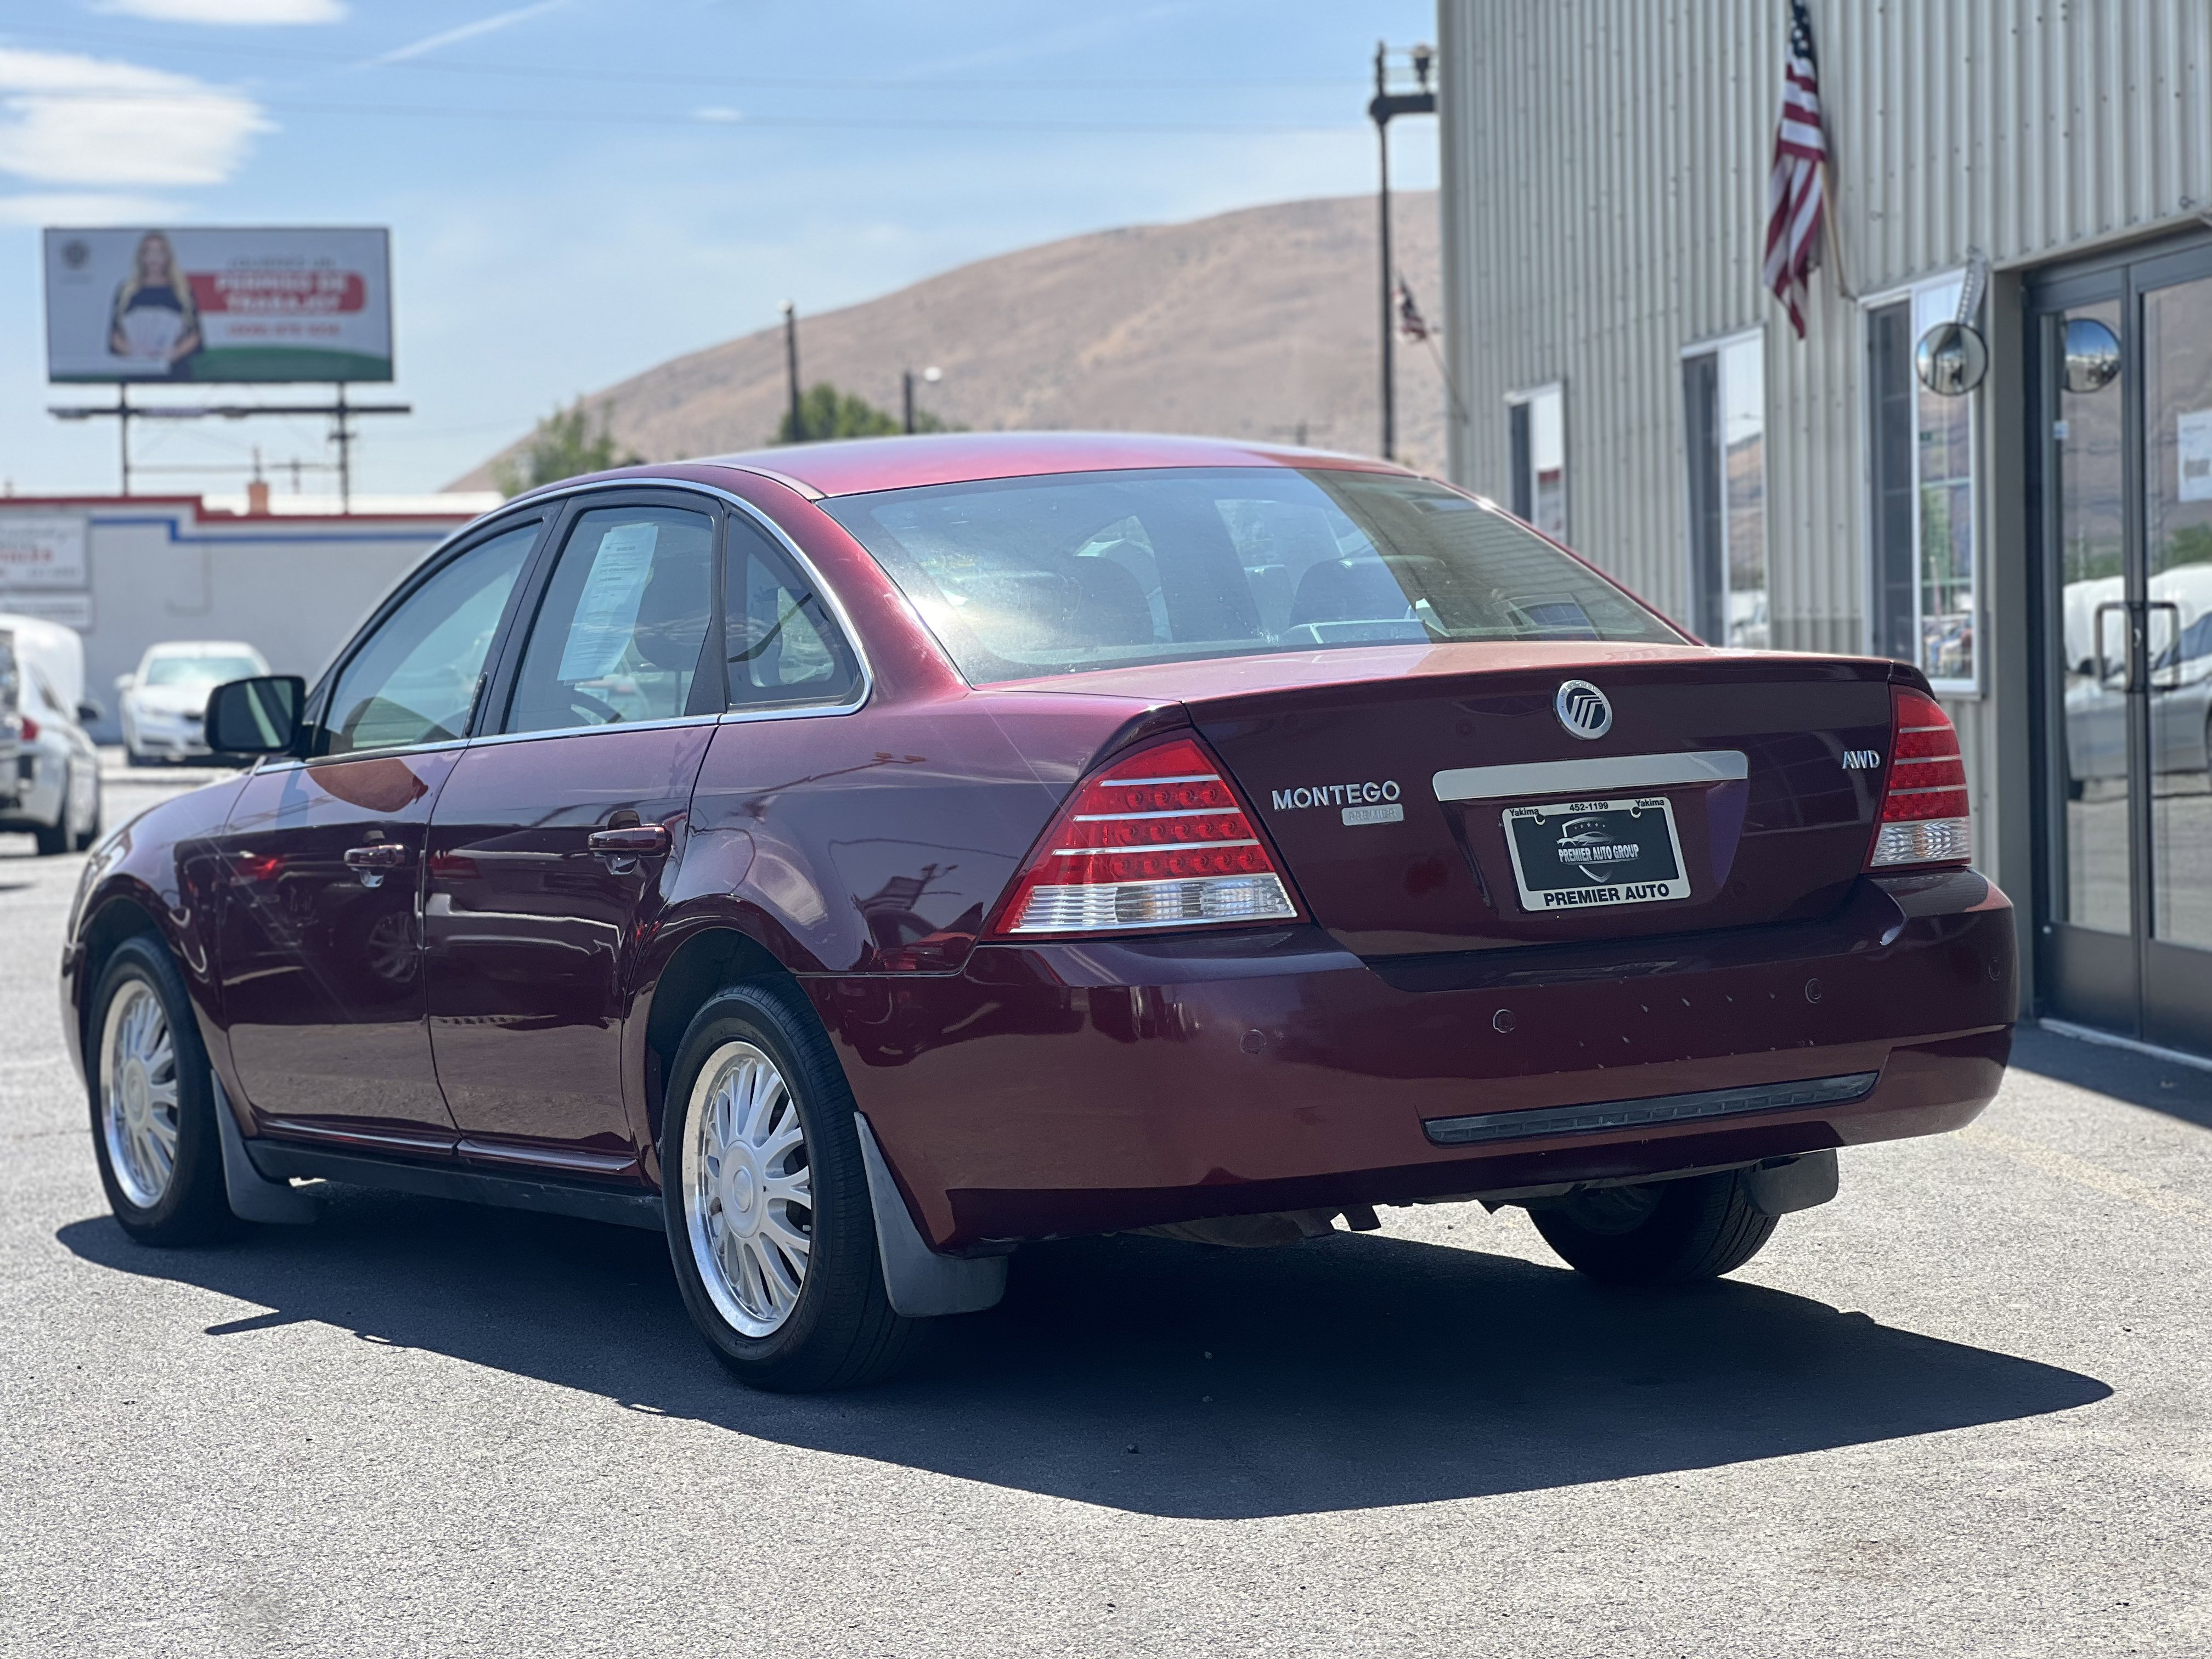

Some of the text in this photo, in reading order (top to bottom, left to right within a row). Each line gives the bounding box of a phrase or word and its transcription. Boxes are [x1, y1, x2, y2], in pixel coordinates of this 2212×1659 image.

[1842, 749, 1880, 769] AWD
[1272, 780, 1400, 810] MONTEGO
[1570, 802, 1609, 811] 452-1199
[1635, 799, 1664, 807] Yakima
[1349, 808, 1397, 821] PREMIER
[1509, 808, 1539, 817] Yakima
[1558, 844, 1639, 862] PREMIER AUTO GROUP
[1543, 883, 1669, 907] PREMIER AUTO
